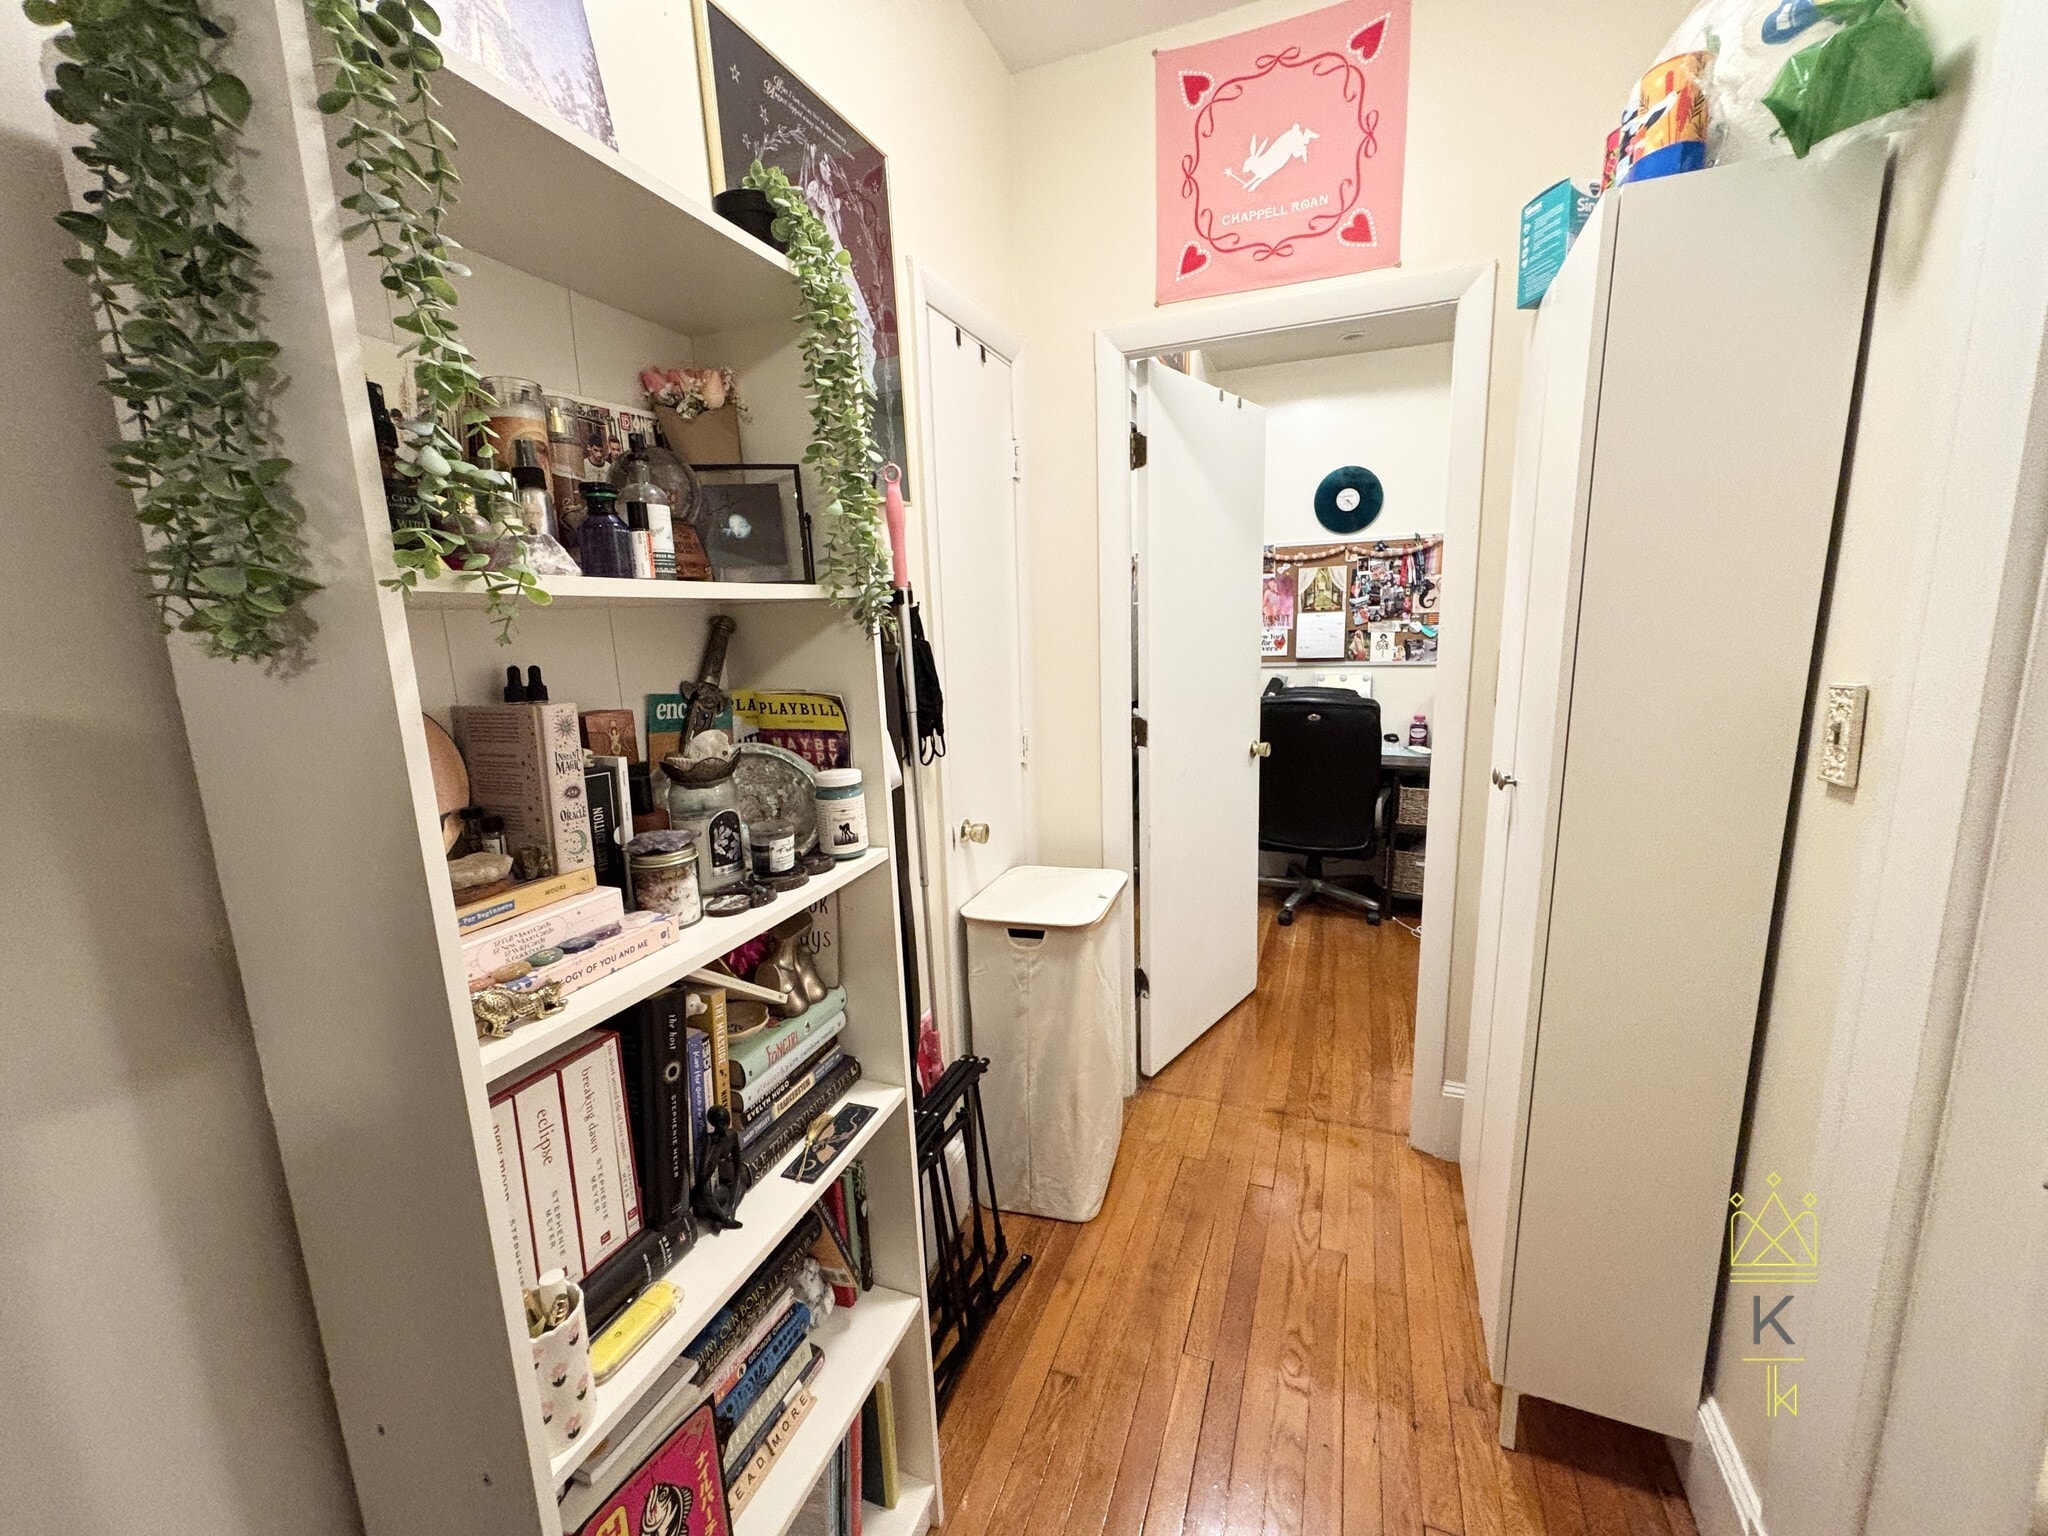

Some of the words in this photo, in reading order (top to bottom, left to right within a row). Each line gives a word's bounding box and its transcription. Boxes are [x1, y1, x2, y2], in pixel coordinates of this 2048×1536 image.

[1221, 205, 1287, 226] CHAPPELL
[1291, 194, 1329, 211] ROAN
[1577, 197, 1597, 212] Sin
[759, 701, 840, 717] PLAYBILL
[772, 737, 838, 752] MAYBE
[802, 751, 839, 766] PPY
[555, 761, 583, 776] MAGIC
[560, 806, 588, 822] ORACLE
[545, 884, 567, 896] MOORE
[563, 969, 583, 984] OGY
[586, 963, 598, 974] OF
[600, 954, 617, 967] YOU
[618, 945, 636, 959] AND
[637, 940, 649, 950] ME
[669, 1013, 677, 1030] the
[715, 1003, 725, 1020] THE
[669, 1033, 677, 1051] host
[716, 1022, 727, 1065] MEASURE
[579, 1065, 596, 1123] breaking
[588, 1122, 600, 1154] dawn
[746, 1096, 771, 1121] EVELYN
[772, 1080, 790, 1099] HUGO
[670, 1094, 678, 1147] STEPHENIE
[532, 1109, 555, 1166] eclipse
[591, 1175, 601, 1214] MEYER
[596, 1157, 609, 1221] STEPHENIE
[545, 1208, 556, 1249] MEYER
[551, 1190, 567, 1257] STEPHENIE
[720, 1312, 740, 1340] OUR
[733, 1456, 766, 1503] EAD
[771, 1394, 808, 1448] MORE
